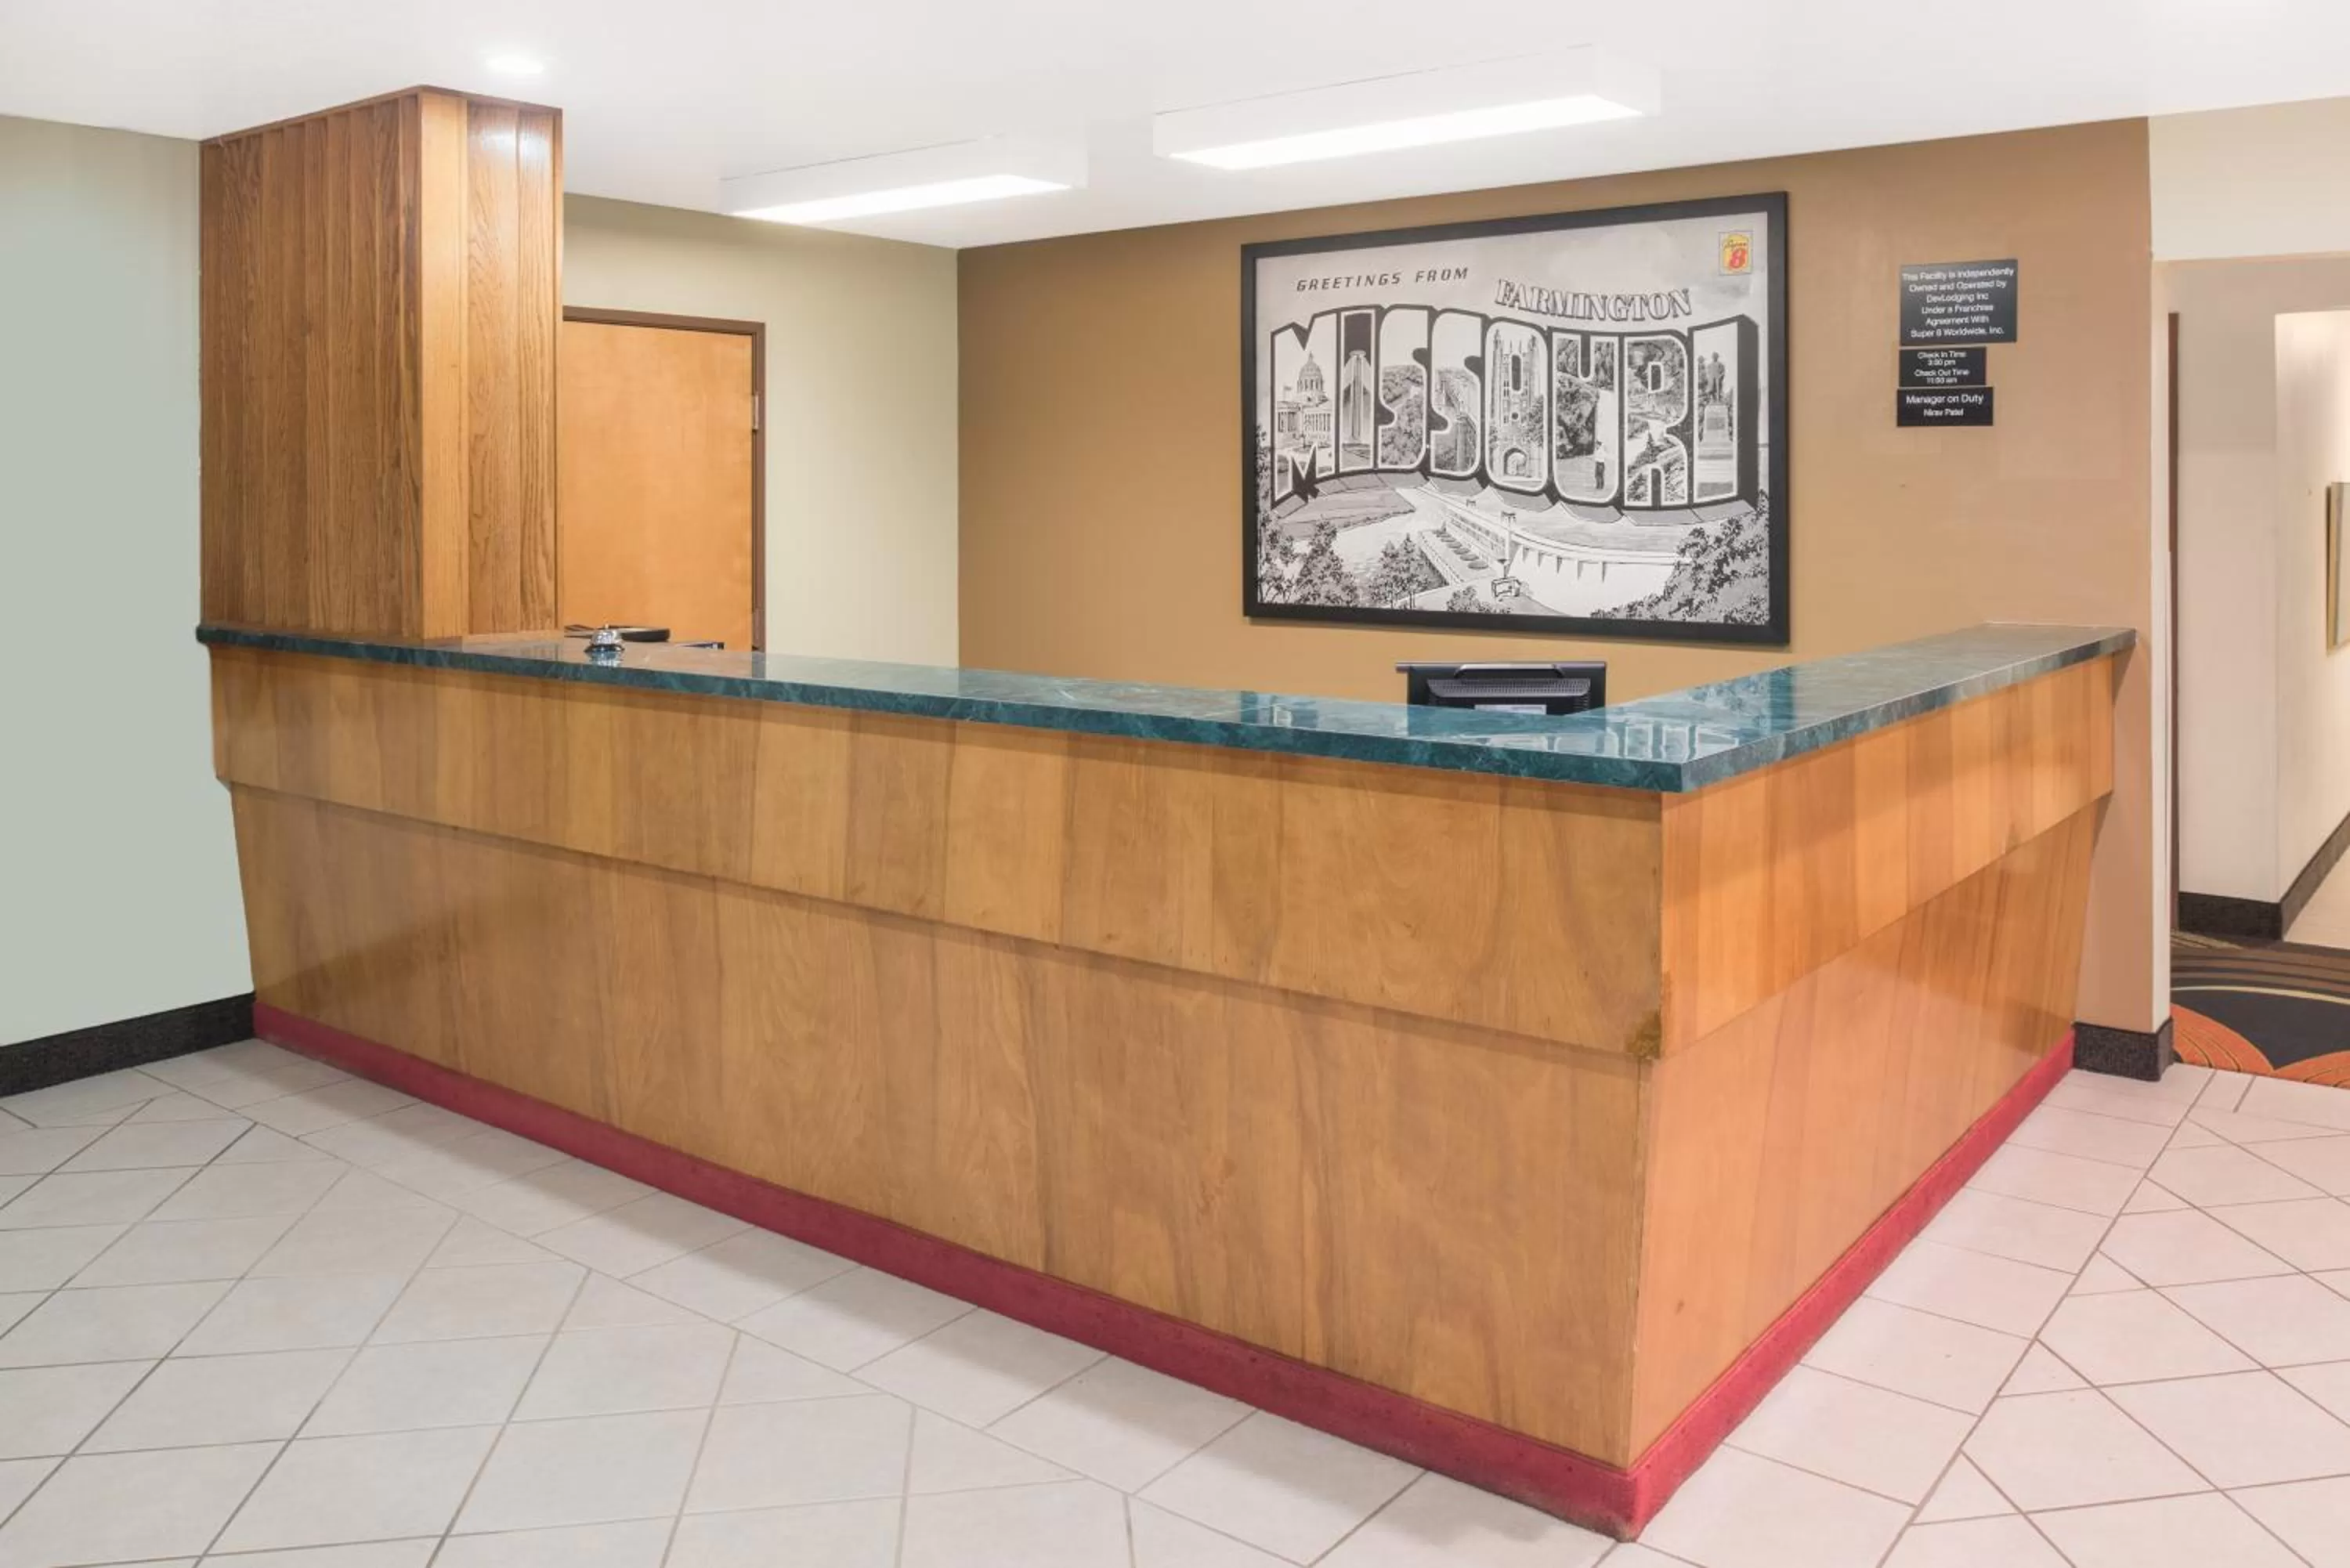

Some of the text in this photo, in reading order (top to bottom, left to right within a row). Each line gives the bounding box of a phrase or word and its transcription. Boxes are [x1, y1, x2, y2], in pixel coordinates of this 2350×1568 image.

[1296, 267, 1469, 292] GREETINGS FROM
[1908, 284, 1938, 292] Owned
[1956, 280, 1994, 290] Operated
[1494, 279, 1692, 322] FARMINGTON
[1922, 305, 1945, 314] Under
[1925, 316, 1969, 327] Agreement
[1911, 329, 1935, 338] Super
[1906, 395, 1946, 405] Manager
[1961, 394, 1984, 405] Duty
[1270, 304, 1759, 512] MISSOURI
